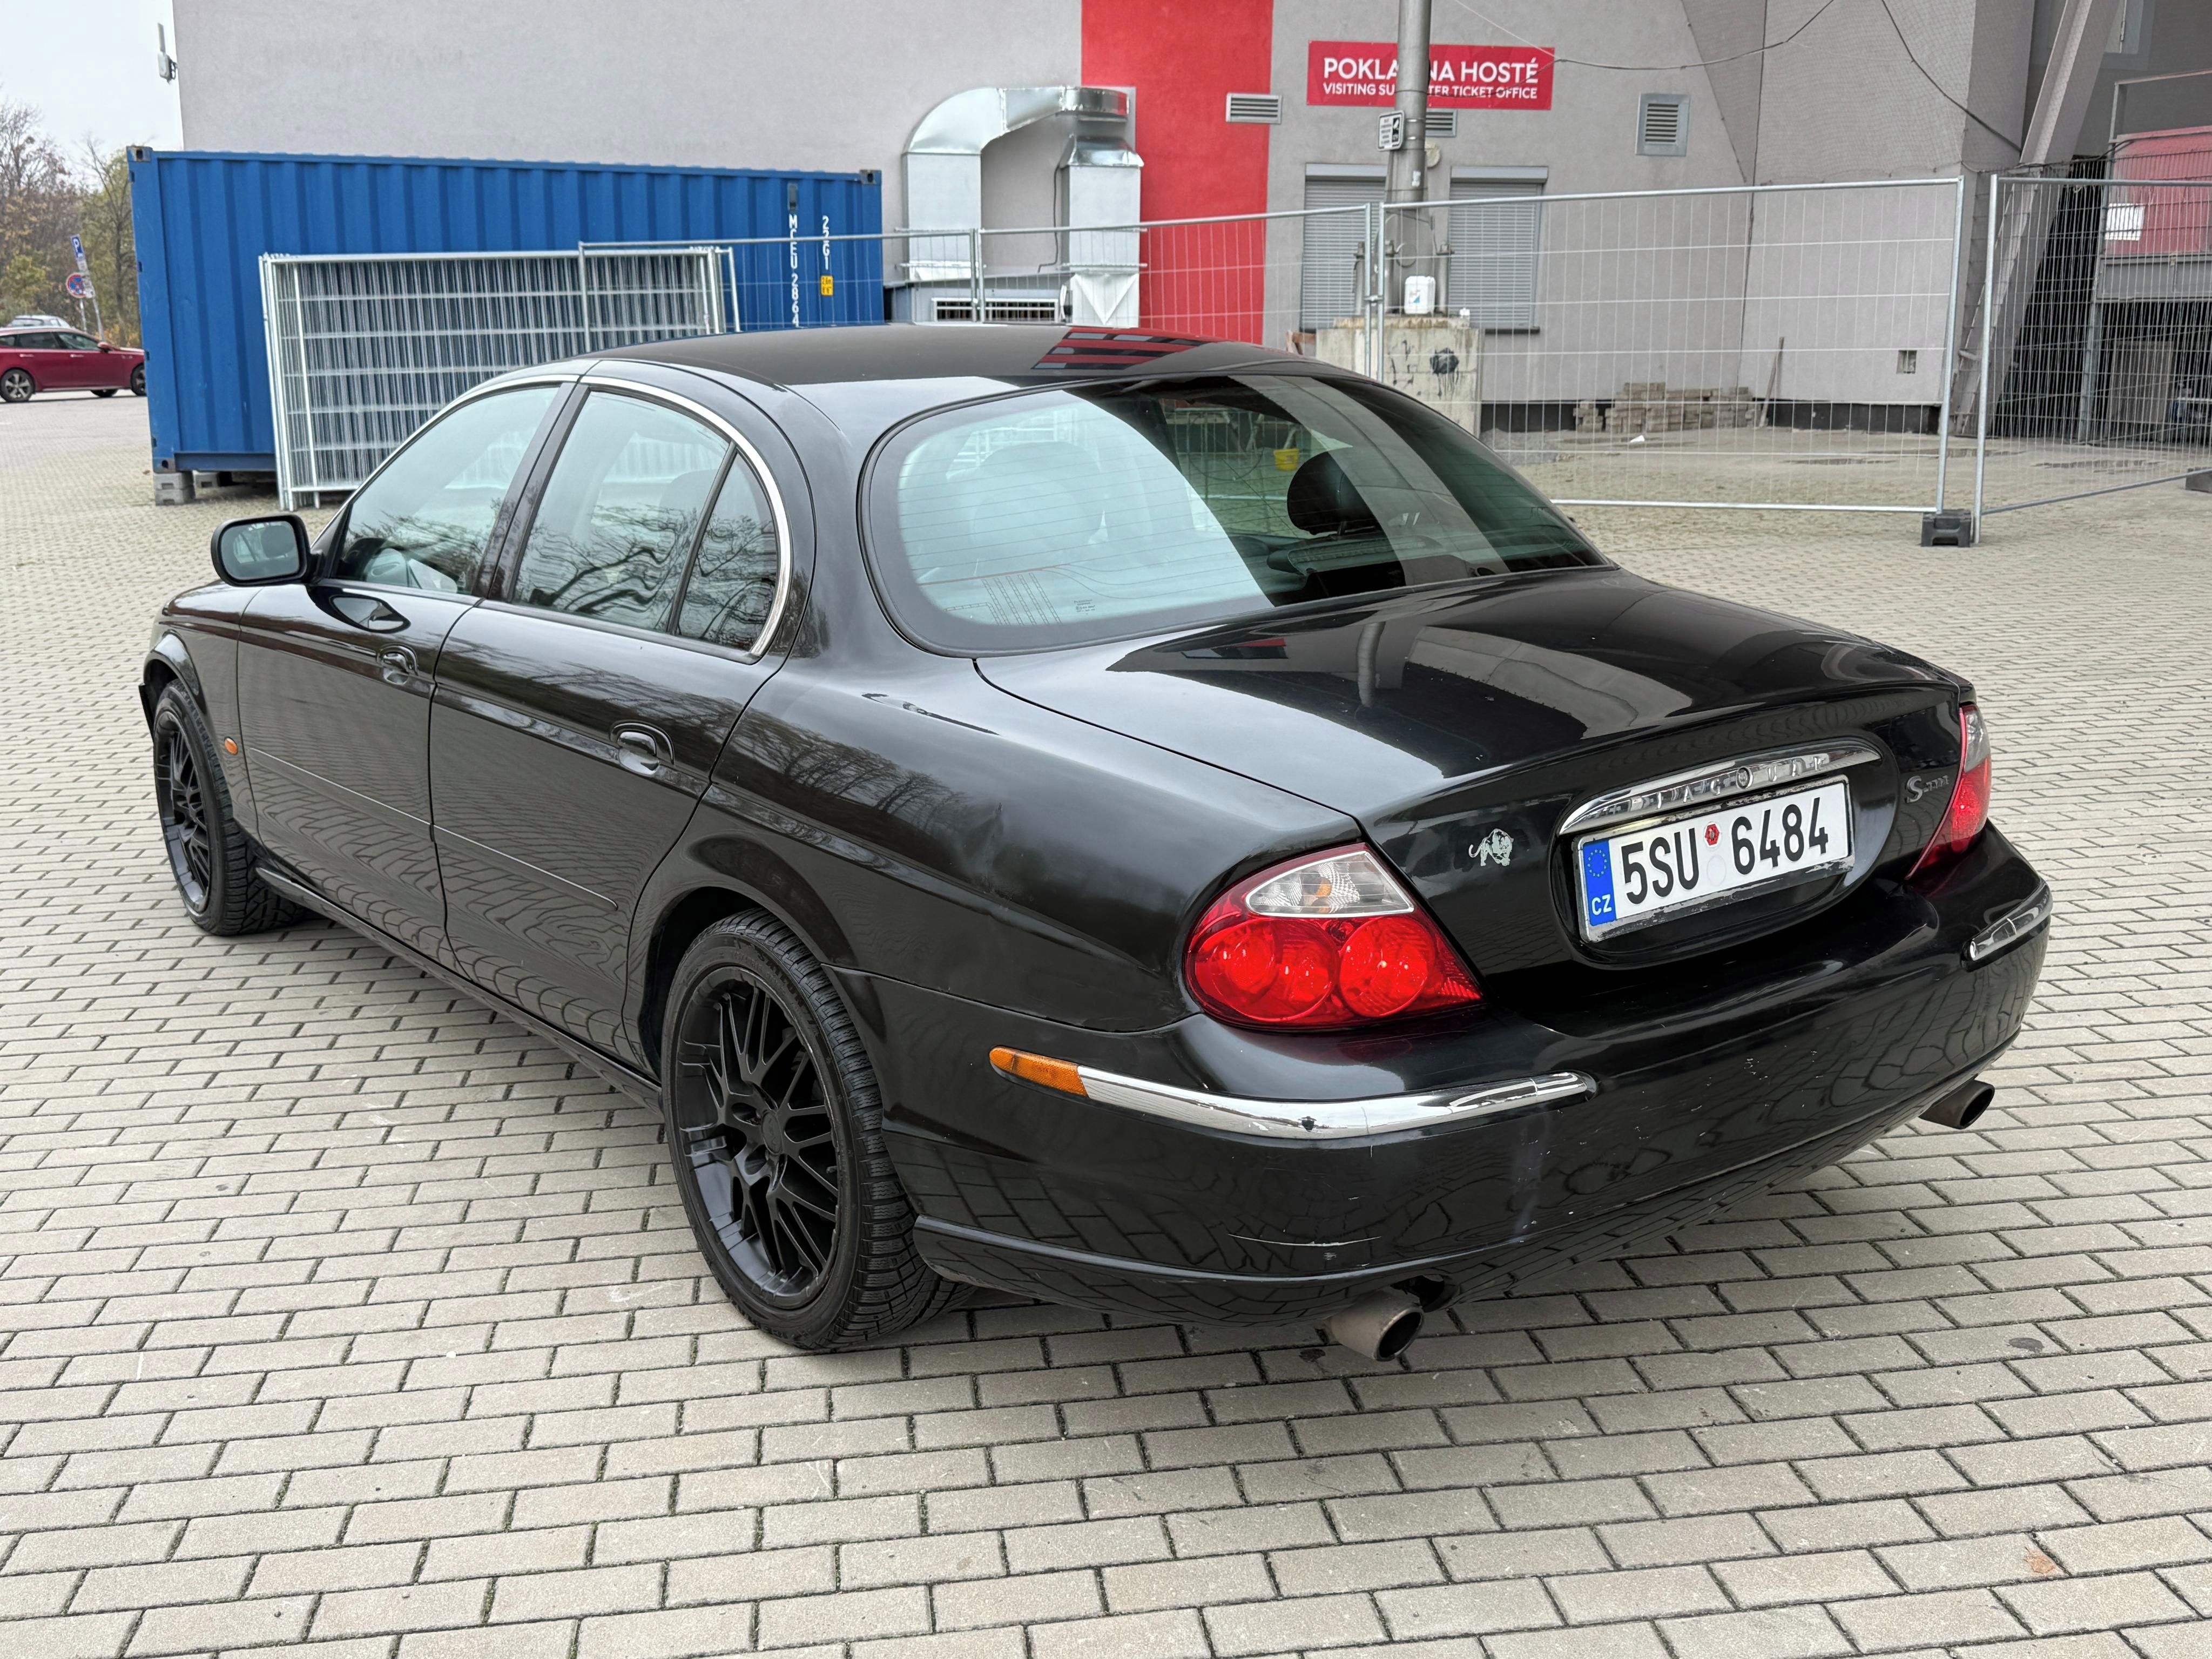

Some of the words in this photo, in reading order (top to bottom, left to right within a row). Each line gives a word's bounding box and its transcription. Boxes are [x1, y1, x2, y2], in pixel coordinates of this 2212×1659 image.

[1461, 57, 1539, 83] HOSTÉ
[1323, 82, 1376, 96] VISITING
[1379, 84, 1449, 96] SUTER
[1452, 86, 1494, 98] TICKET
[1496, 87, 1537, 99] OFFICE
[1621, 827, 1700, 905] 5SU
[1731, 797, 1829, 875] 6484
[1591, 894, 1612, 915] CZ
